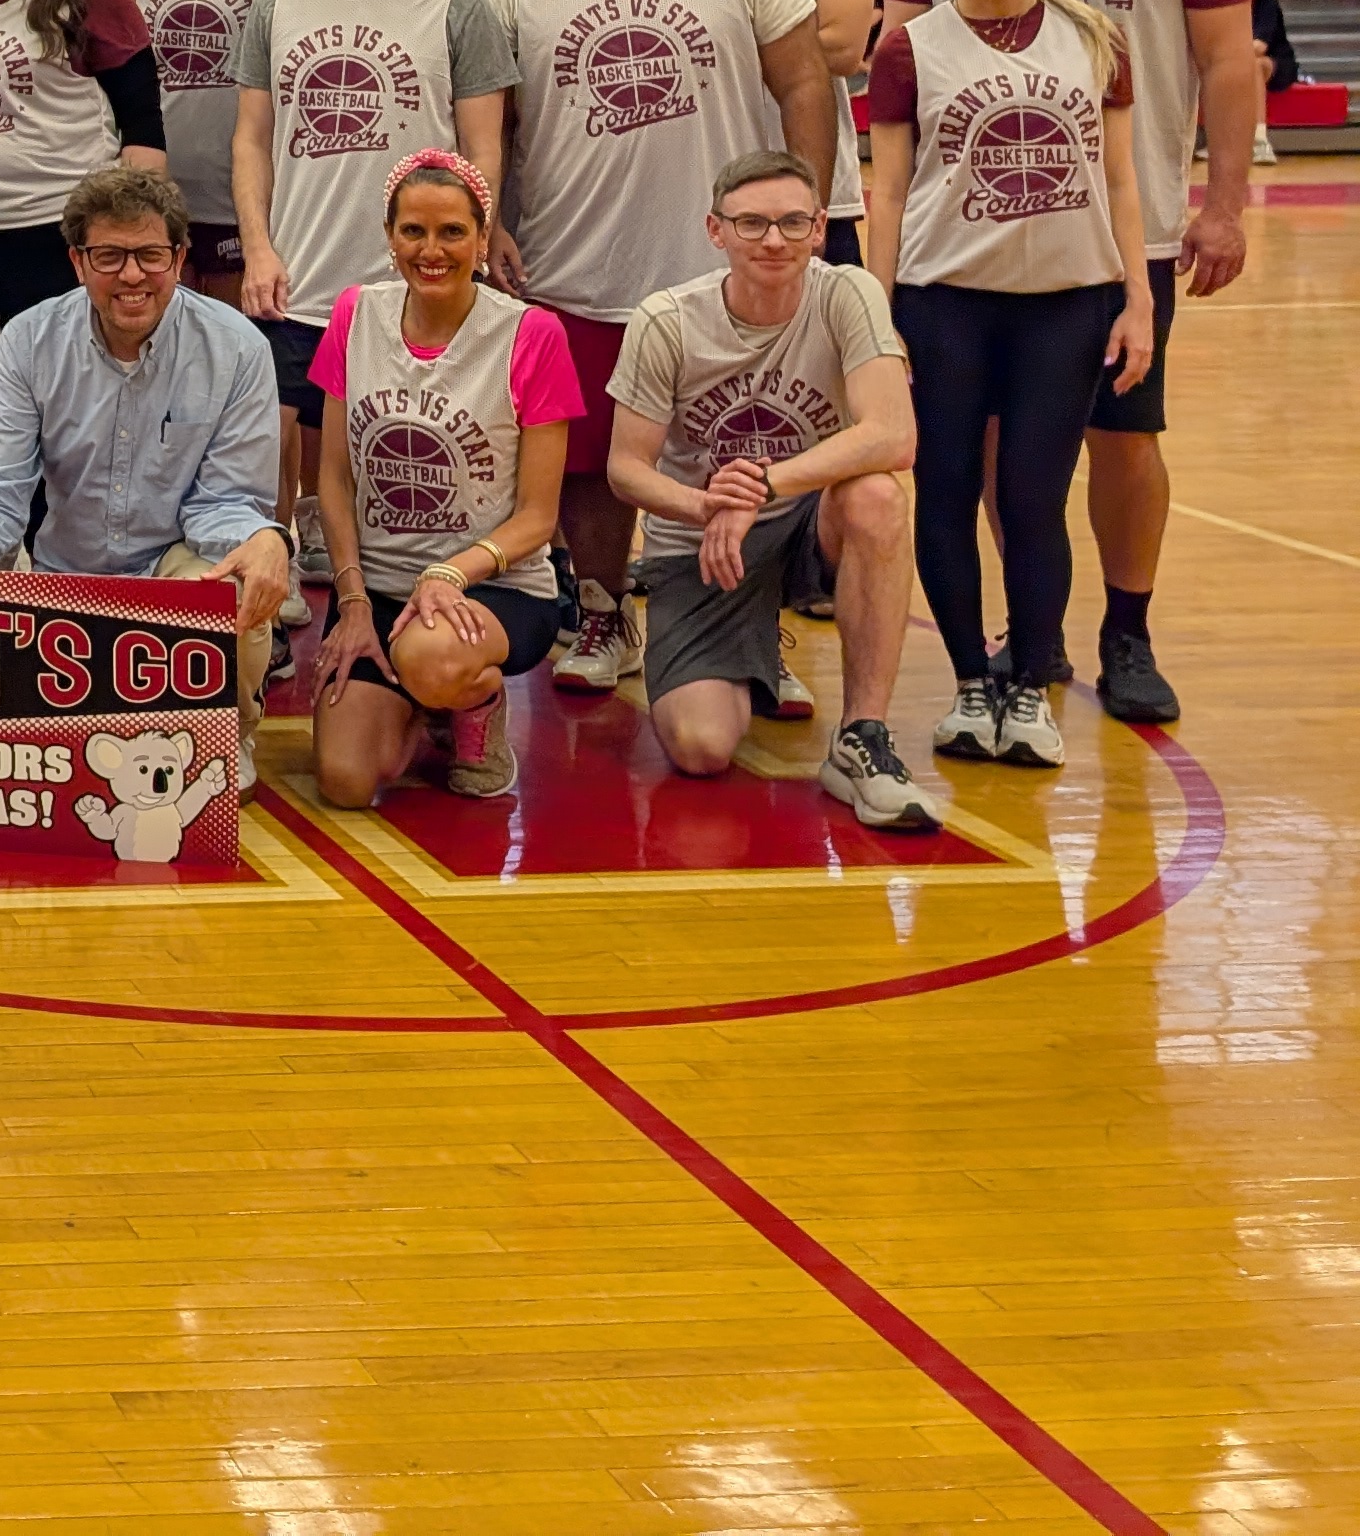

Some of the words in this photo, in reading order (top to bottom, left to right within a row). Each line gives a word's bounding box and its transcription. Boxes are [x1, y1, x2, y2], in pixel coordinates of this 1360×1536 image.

[155, 31, 231, 51] BASKETBALL
[662, 2, 716, 69] STAFF
[279, 24, 343, 107] PARENTS
[353, 24, 383, 52] VS
[378, 42, 421, 112] STAFF
[587, 58, 682, 85] BASKETBALL
[298, 90, 384, 110] BASKETBALL
[585, 94, 698, 137] Connors
[938, 73, 1015, 166] PARENTS
[1022, 73, 1060, 101] VS
[1061, 87, 1100, 164] STAFF
[288, 127, 389, 158] Connors
[970, 147, 1078, 166] BASKETBALL
[961, 187, 1090, 223] Connors
[759, 368, 783, 396] VS
[349, 388, 409, 468] PARENTS
[418, 389, 450, 422] VS
[445, 408, 495, 482] STAFF
[365, 458, 458, 488] BASKETBALL
[364, 494, 470, 529] Connors
[112, 630, 227, 705] GO
